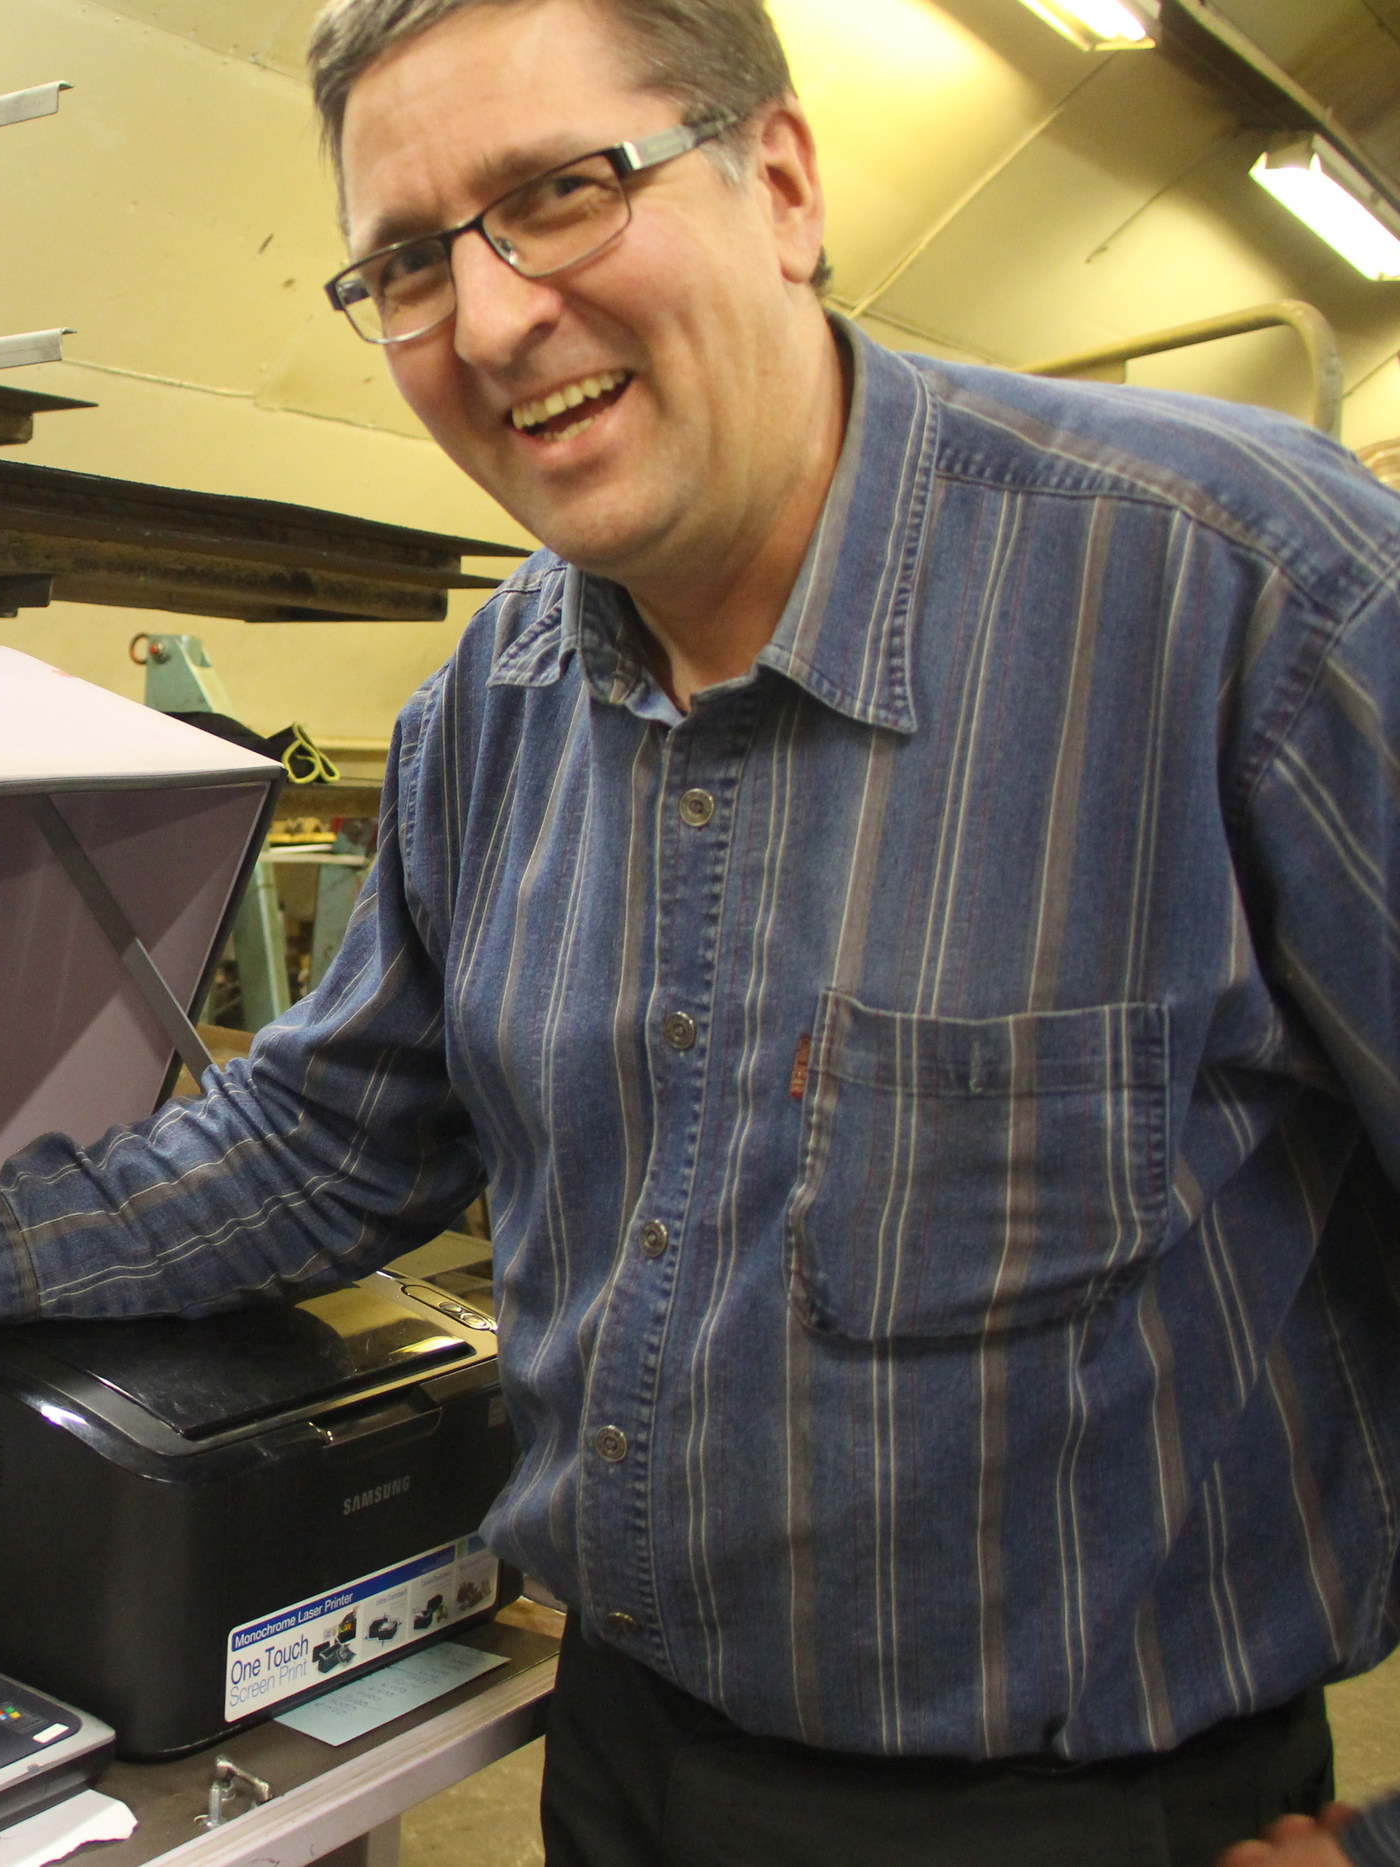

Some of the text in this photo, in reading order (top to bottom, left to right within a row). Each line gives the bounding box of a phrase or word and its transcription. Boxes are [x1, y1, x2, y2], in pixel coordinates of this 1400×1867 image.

[343, 1475, 410, 1516] SAMSUNG
[234, 1592, 354, 1649] Monochrome Laser Printer
[229, 1674, 276, 1707] Screen
[279, 1660, 307, 1687] Print
[231, 1634, 309, 1685] One Touch
